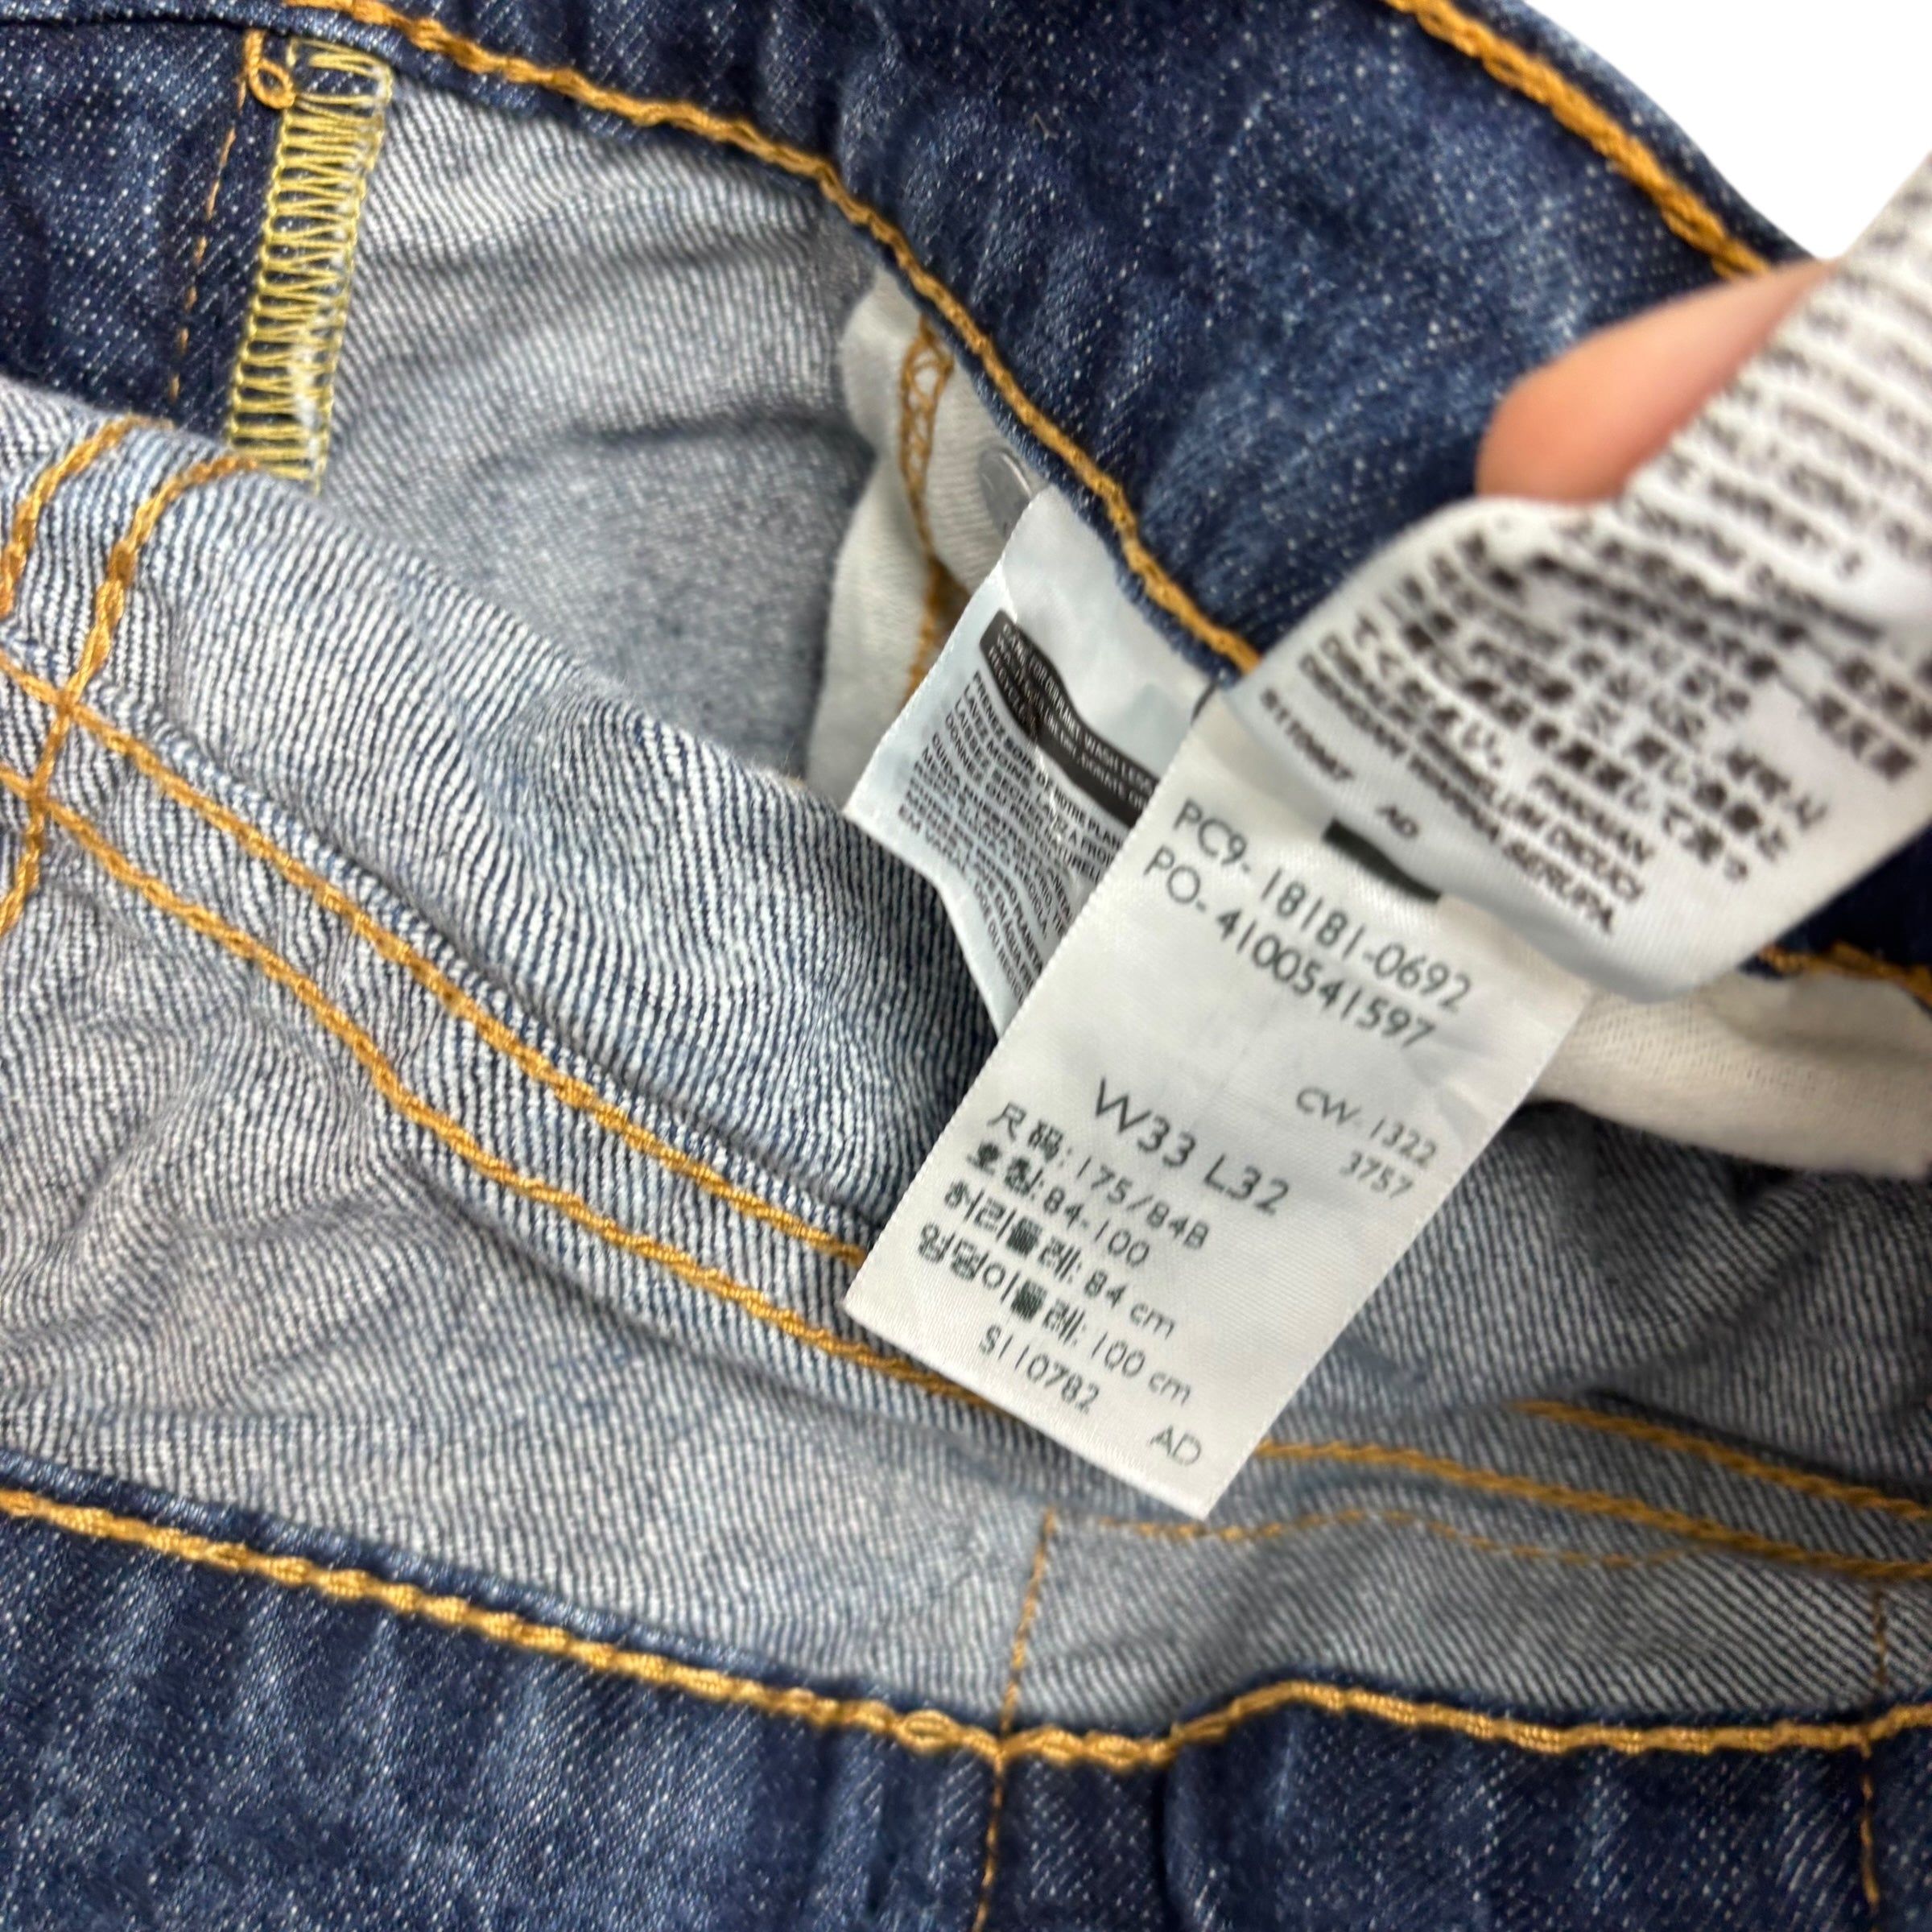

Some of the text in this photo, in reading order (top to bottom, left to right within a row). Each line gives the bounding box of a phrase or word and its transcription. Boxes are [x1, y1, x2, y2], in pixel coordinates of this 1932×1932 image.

[1096, 1076, 1290, 1216] W33 L32
[1339, 1150, 1414, 1199] 3757
[1084, 1269, 1126, 1309] 84
[1129, 1302, 1174, 1340] cm
[979, 1323, 1202, 1466] S110782 AD
[1091, 1331, 1146, 1377] 100
[1148, 1371, 1191, 1406] cm
